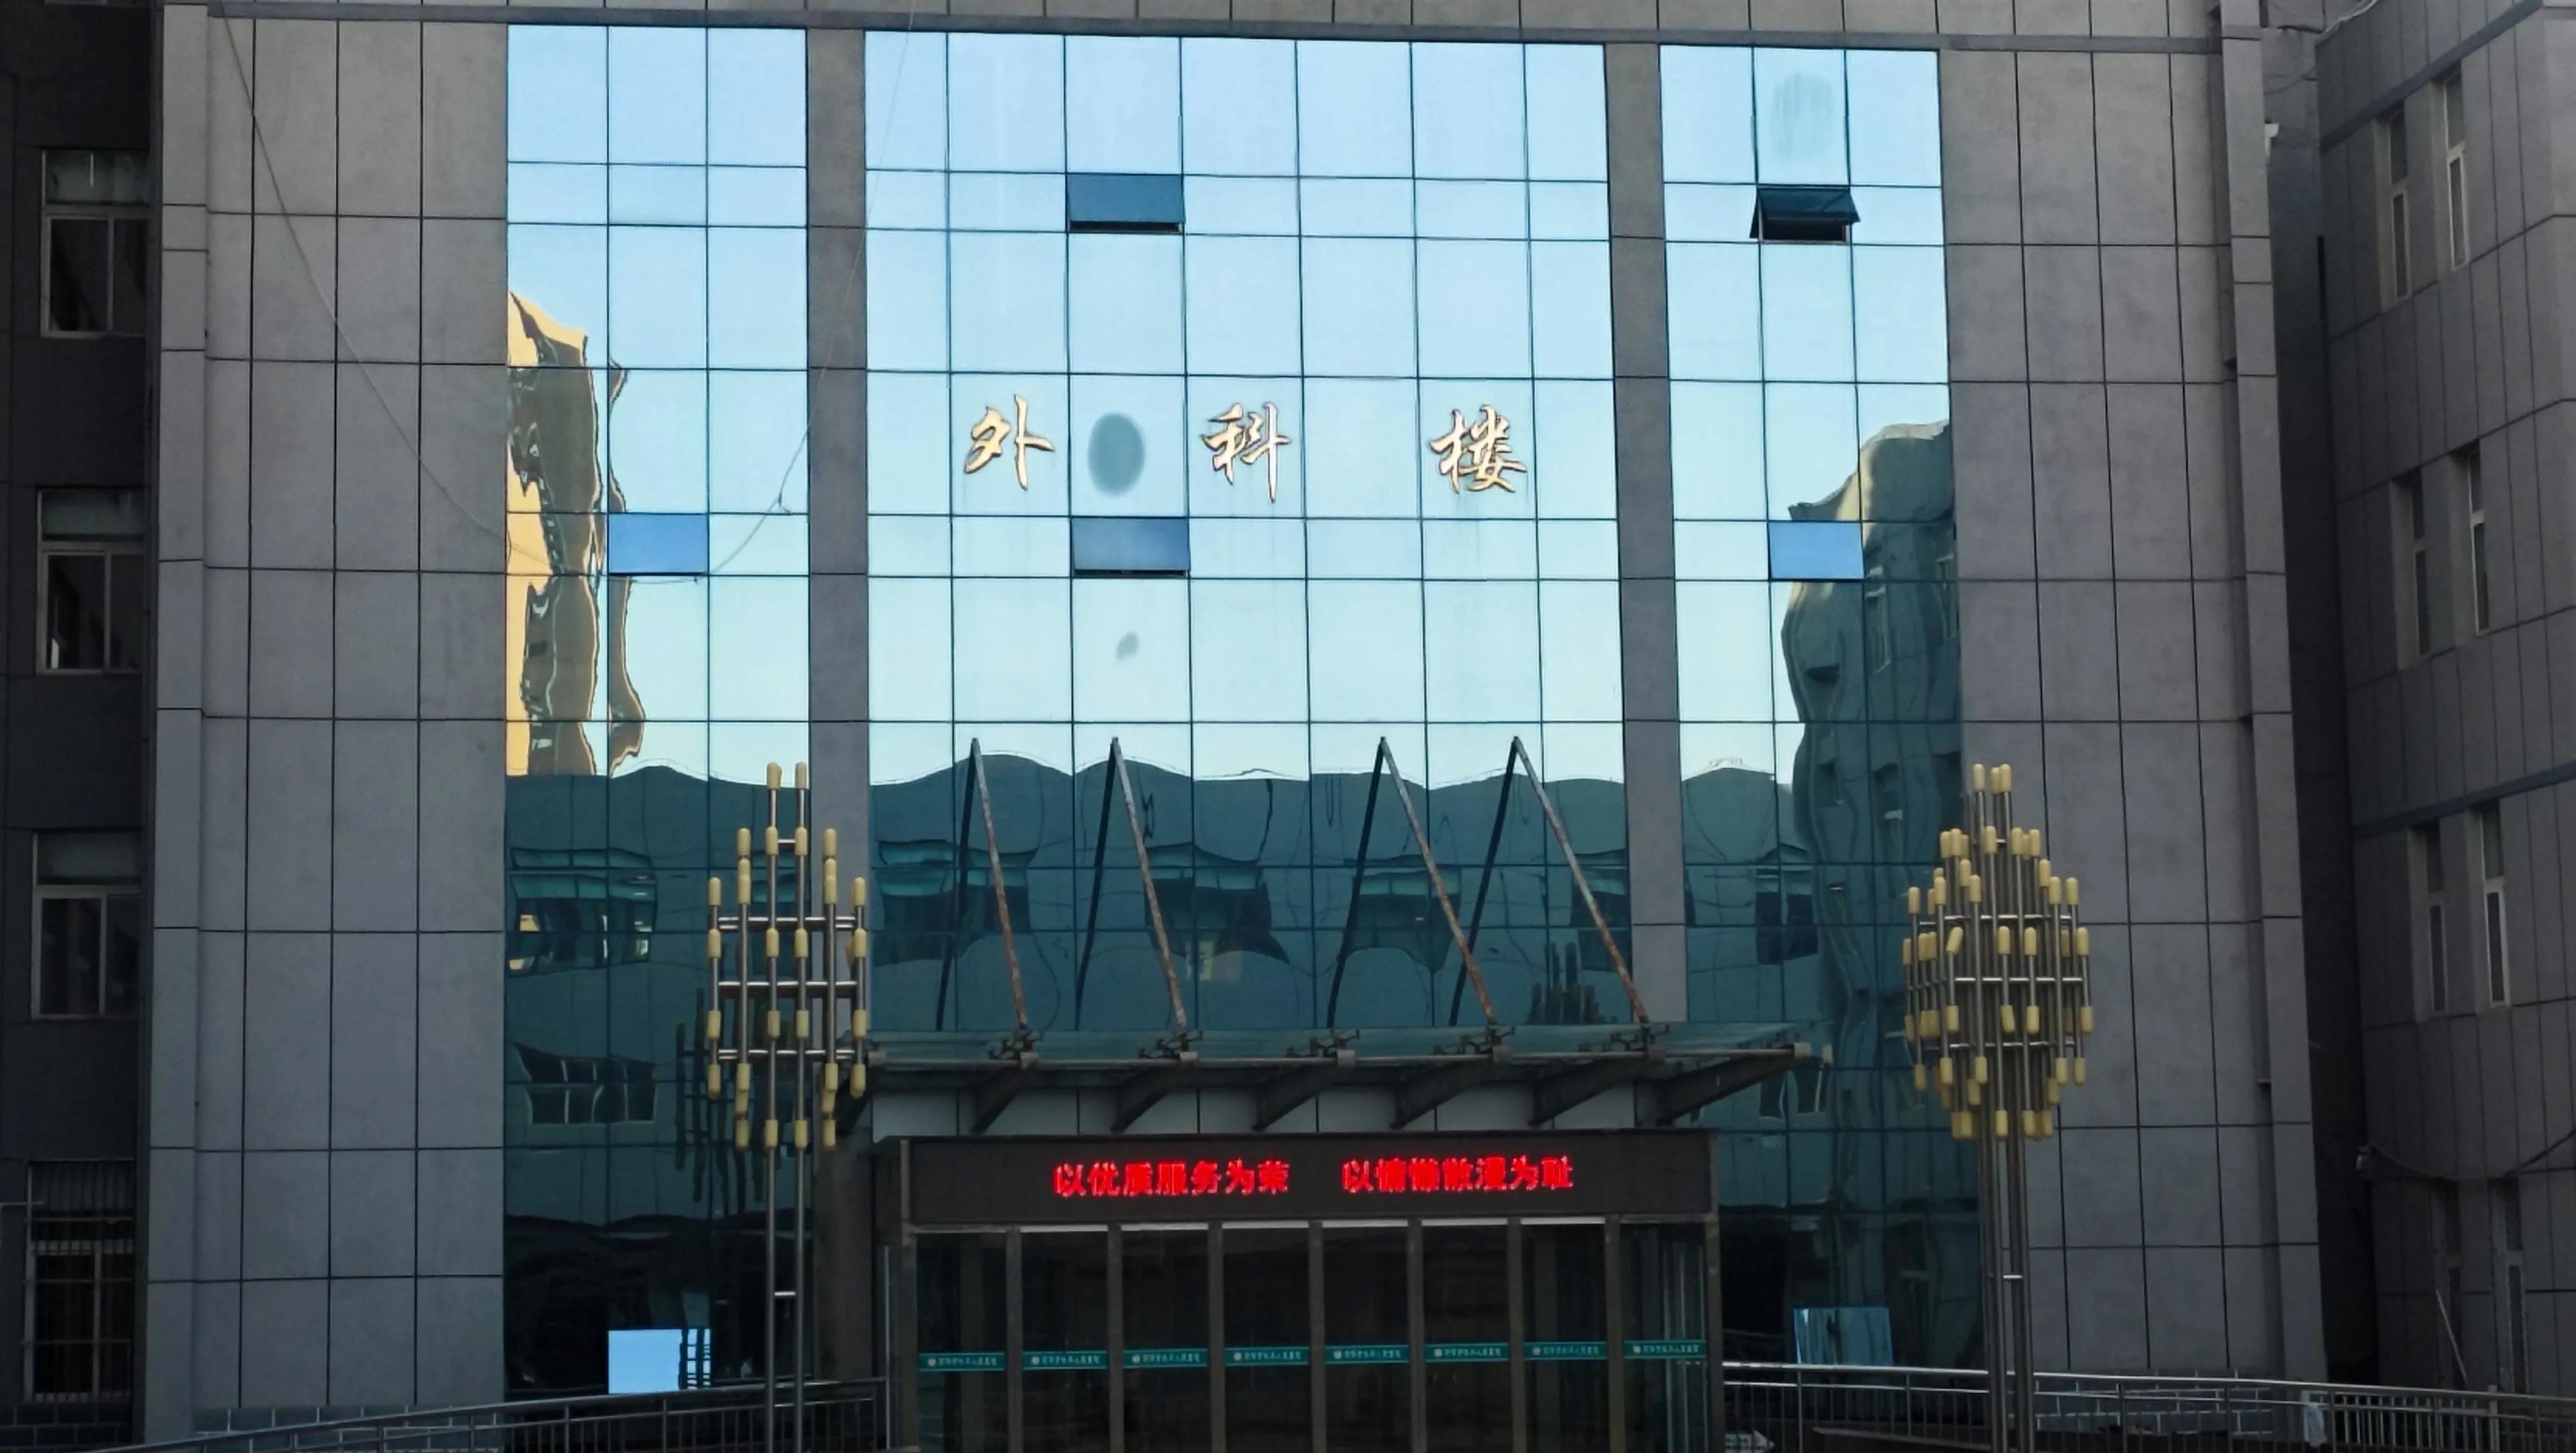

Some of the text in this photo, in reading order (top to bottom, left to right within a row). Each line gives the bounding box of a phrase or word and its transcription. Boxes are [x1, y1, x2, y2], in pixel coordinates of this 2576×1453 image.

[964, 394, 1526, 504] 外科楼
[1054, 1159, 1288, 1197] 以优质服务为荣
